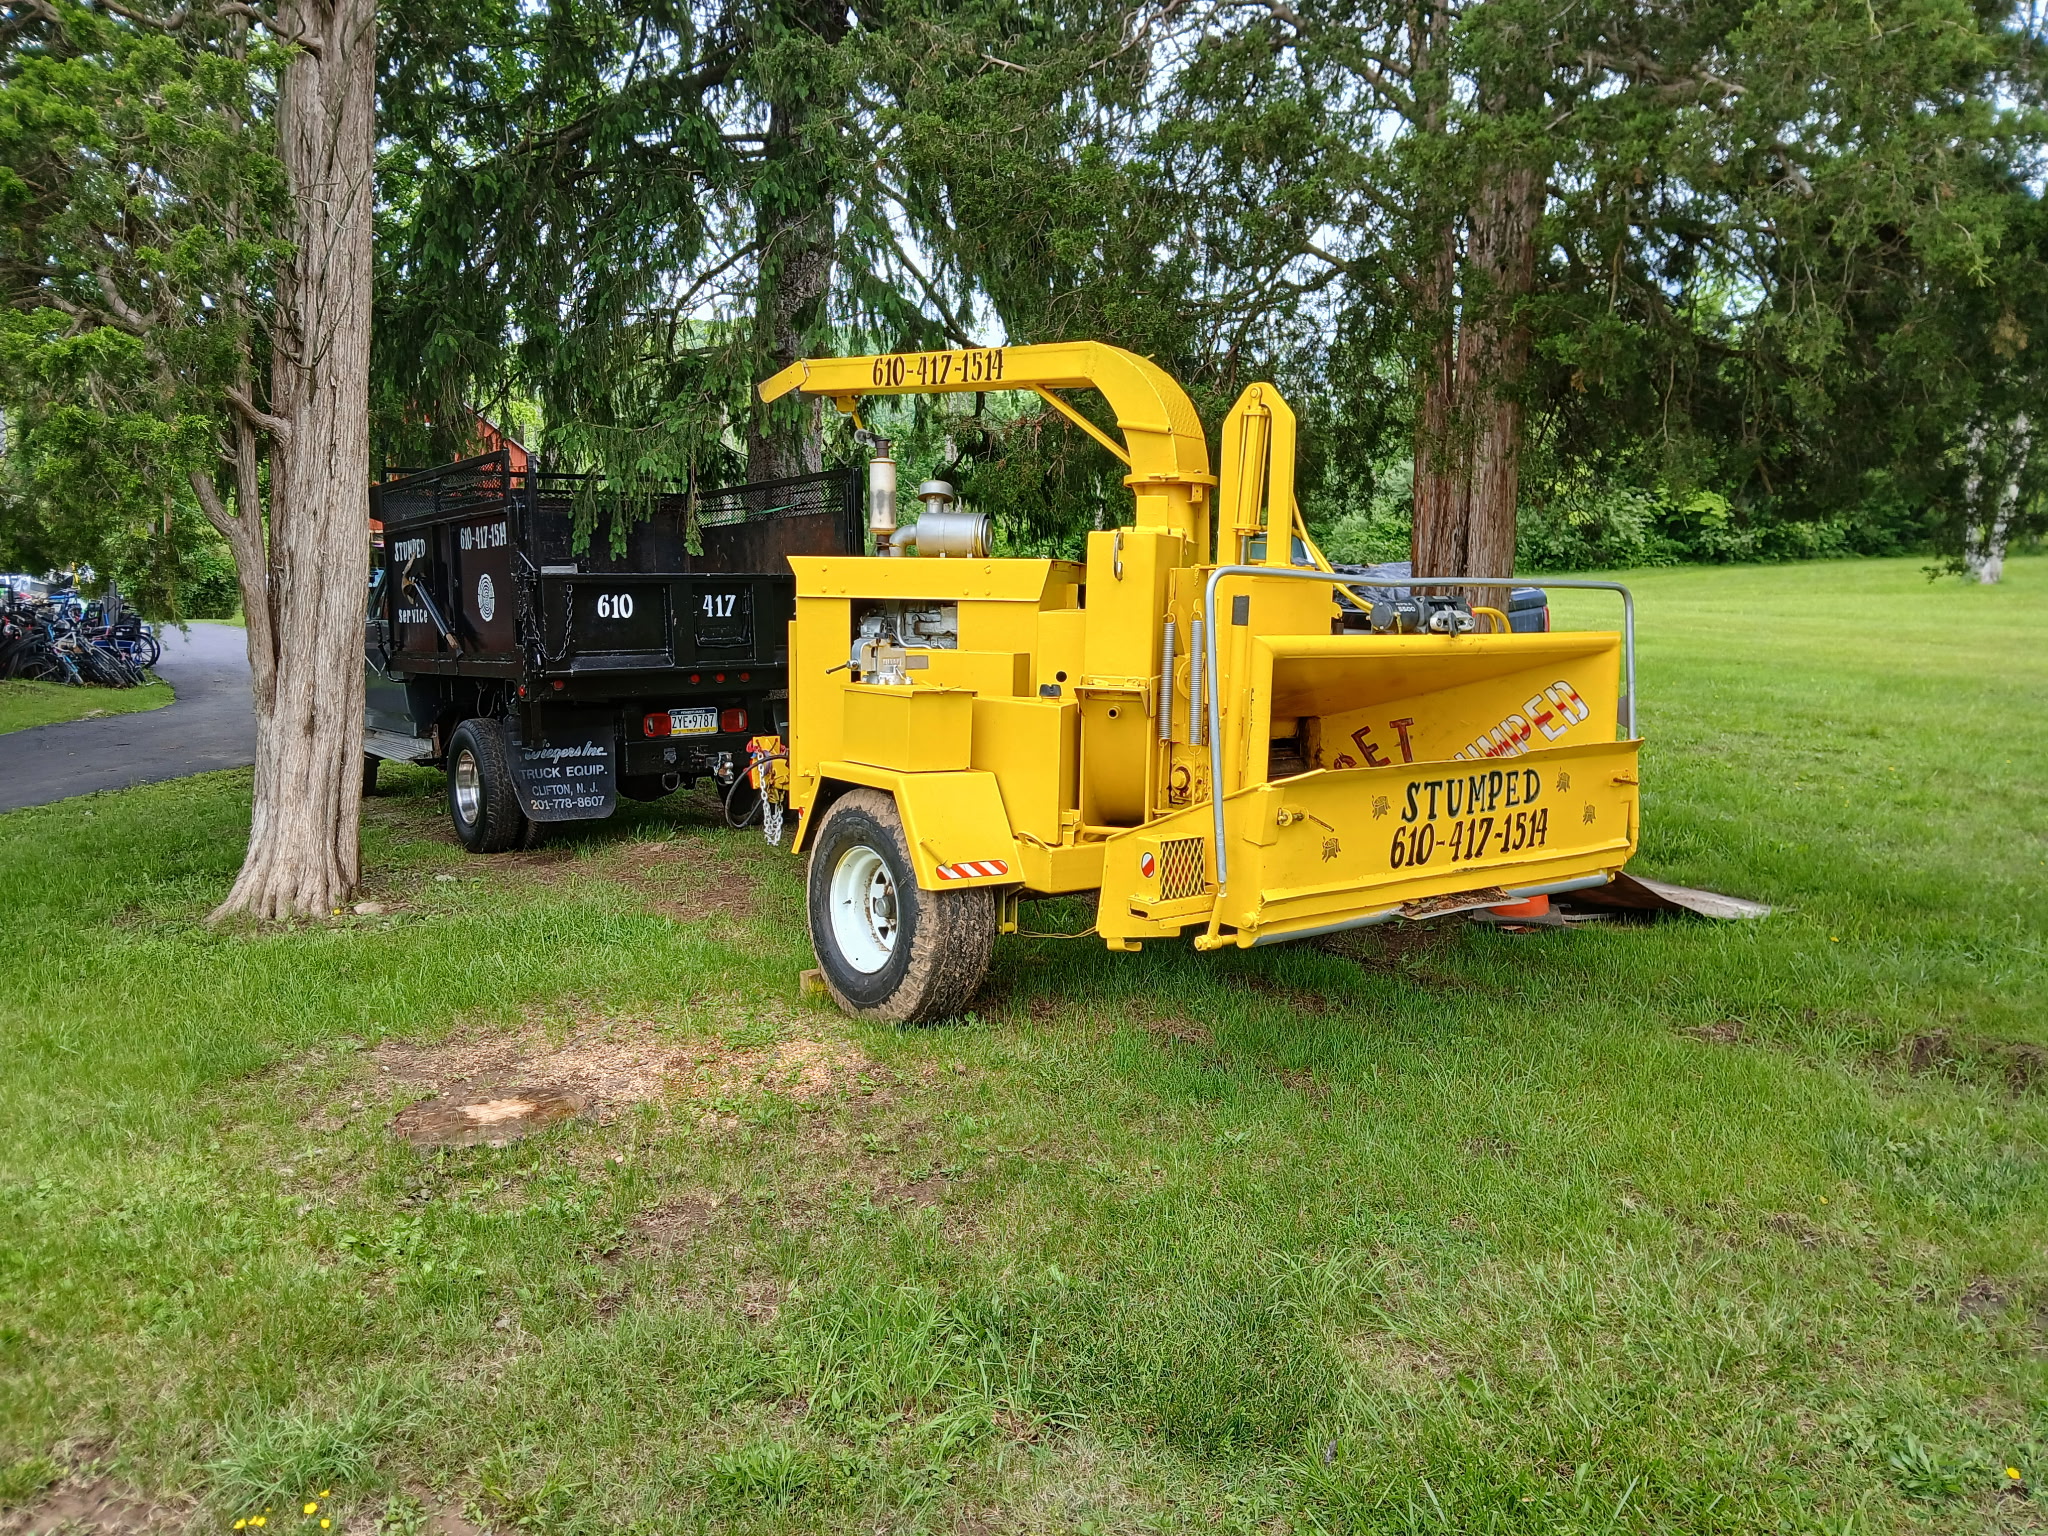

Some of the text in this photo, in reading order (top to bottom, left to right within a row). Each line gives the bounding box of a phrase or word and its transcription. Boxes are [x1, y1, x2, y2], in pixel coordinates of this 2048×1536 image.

[872, 348, 1004, 387] 610-417-1514
[460, 521, 508, 550] 610-417-1514
[597, 593, 737, 619] 610 417
[520, 764, 608, 779] TRUCK EQUIP.
[531, 796, 605, 810] 201-778-8607
[532, 784, 573, 797] CLIFTON,
[1401, 768, 1541, 822] STUMPED
[1390, 808, 1549, 869] 610-417-1514
